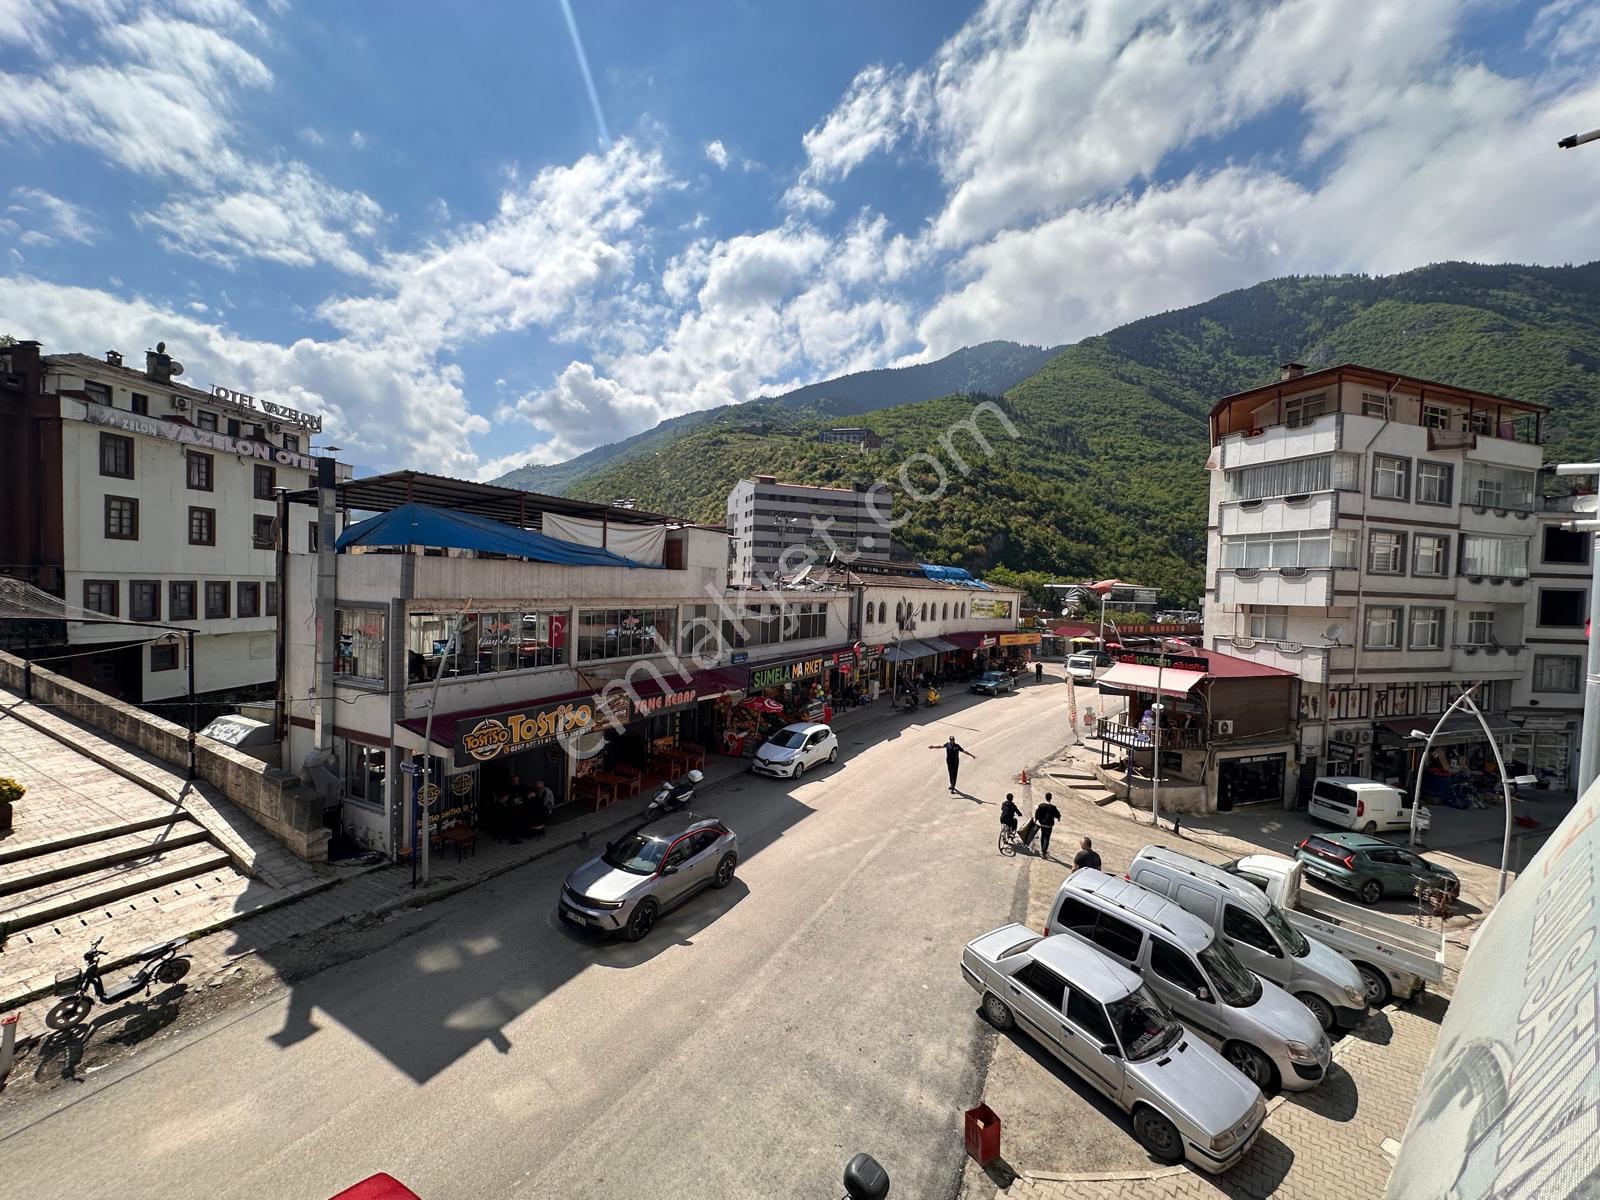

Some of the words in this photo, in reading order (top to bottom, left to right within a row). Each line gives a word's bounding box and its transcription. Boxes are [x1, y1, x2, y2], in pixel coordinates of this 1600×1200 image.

[215, 386, 257, 410] OTEL
[260, 399, 322, 430] VAZELON
[161, 421, 270, 460] VAZELON
[275, 450, 319, 472] OTEL
[753, 664, 791, 690] SUMELA
[791, 658, 823, 679] MARKET
[663, 690, 696, 708] KEBAP
